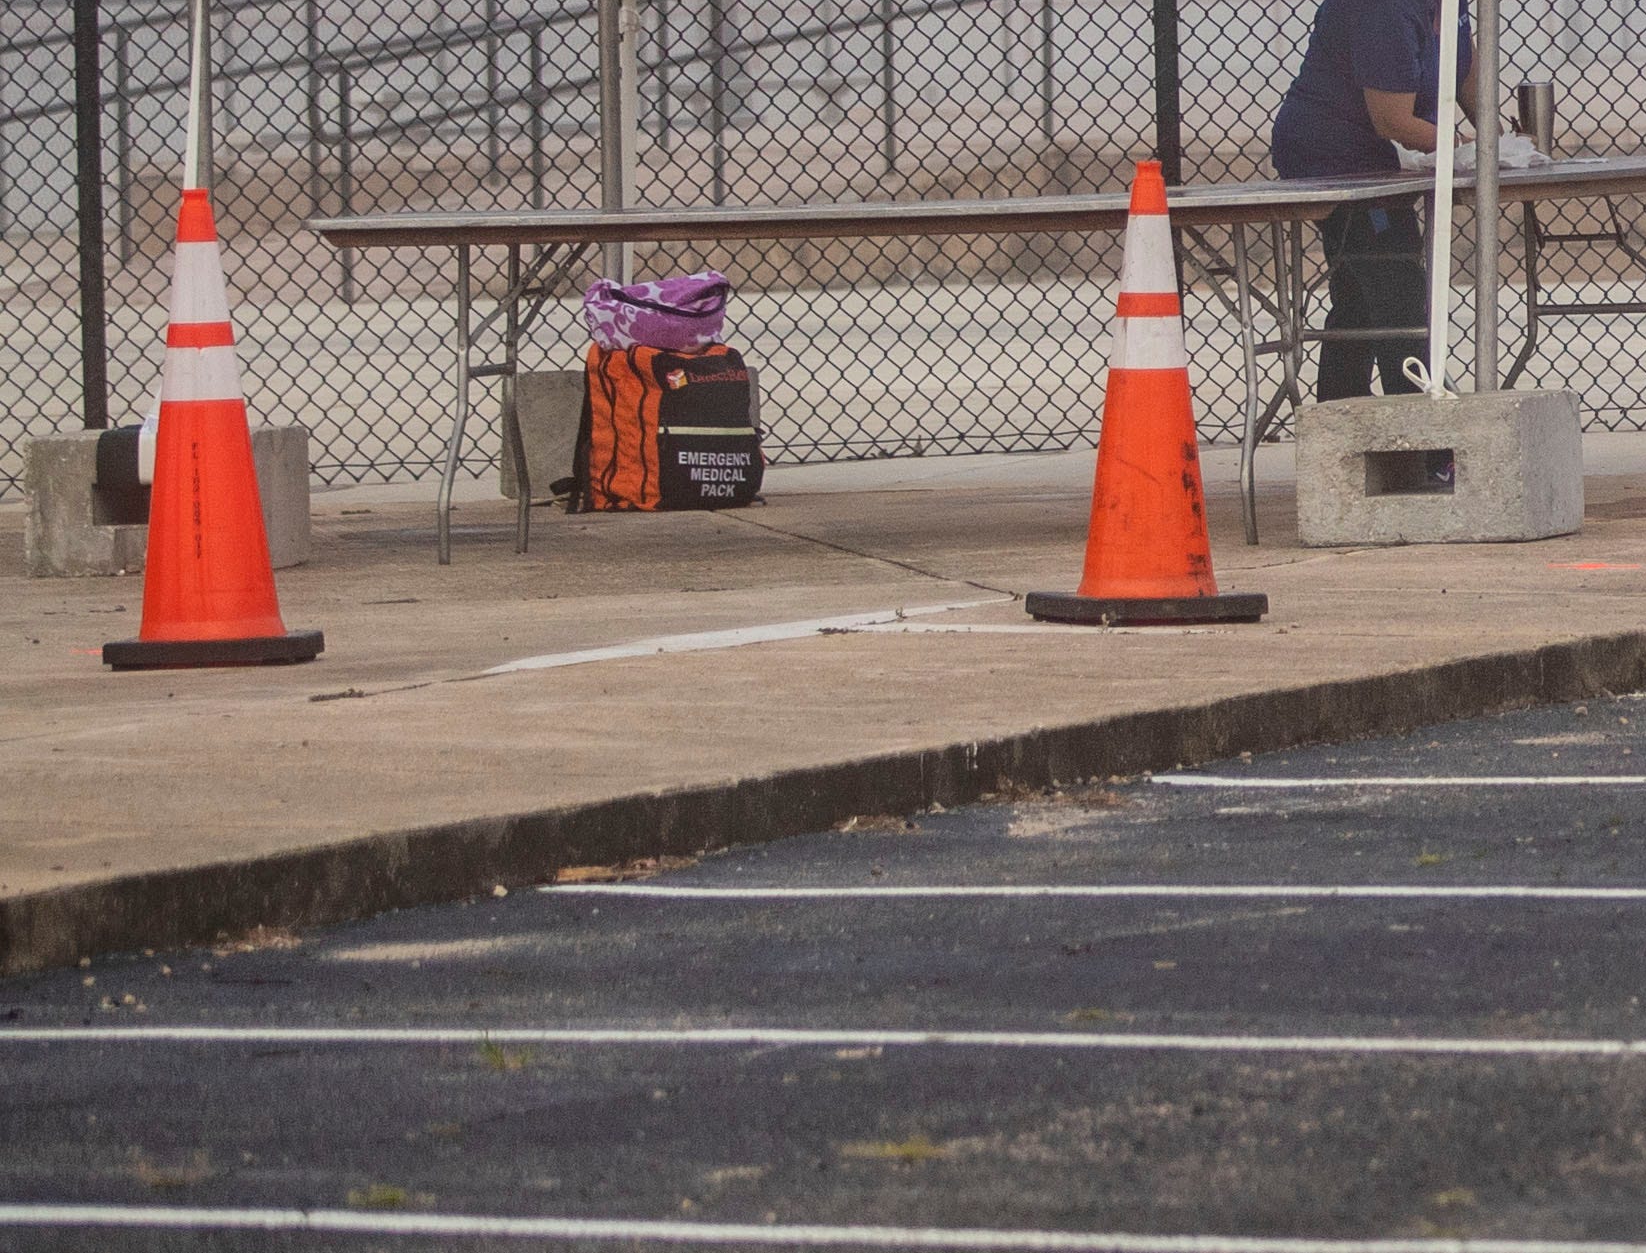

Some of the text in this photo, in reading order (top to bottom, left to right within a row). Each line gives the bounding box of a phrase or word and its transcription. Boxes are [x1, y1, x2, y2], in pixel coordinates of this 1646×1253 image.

[678, 451, 752, 466] EMERGENCY
[690, 467, 747, 482] MEDICAL
[700, 483, 736, 497] PACK
